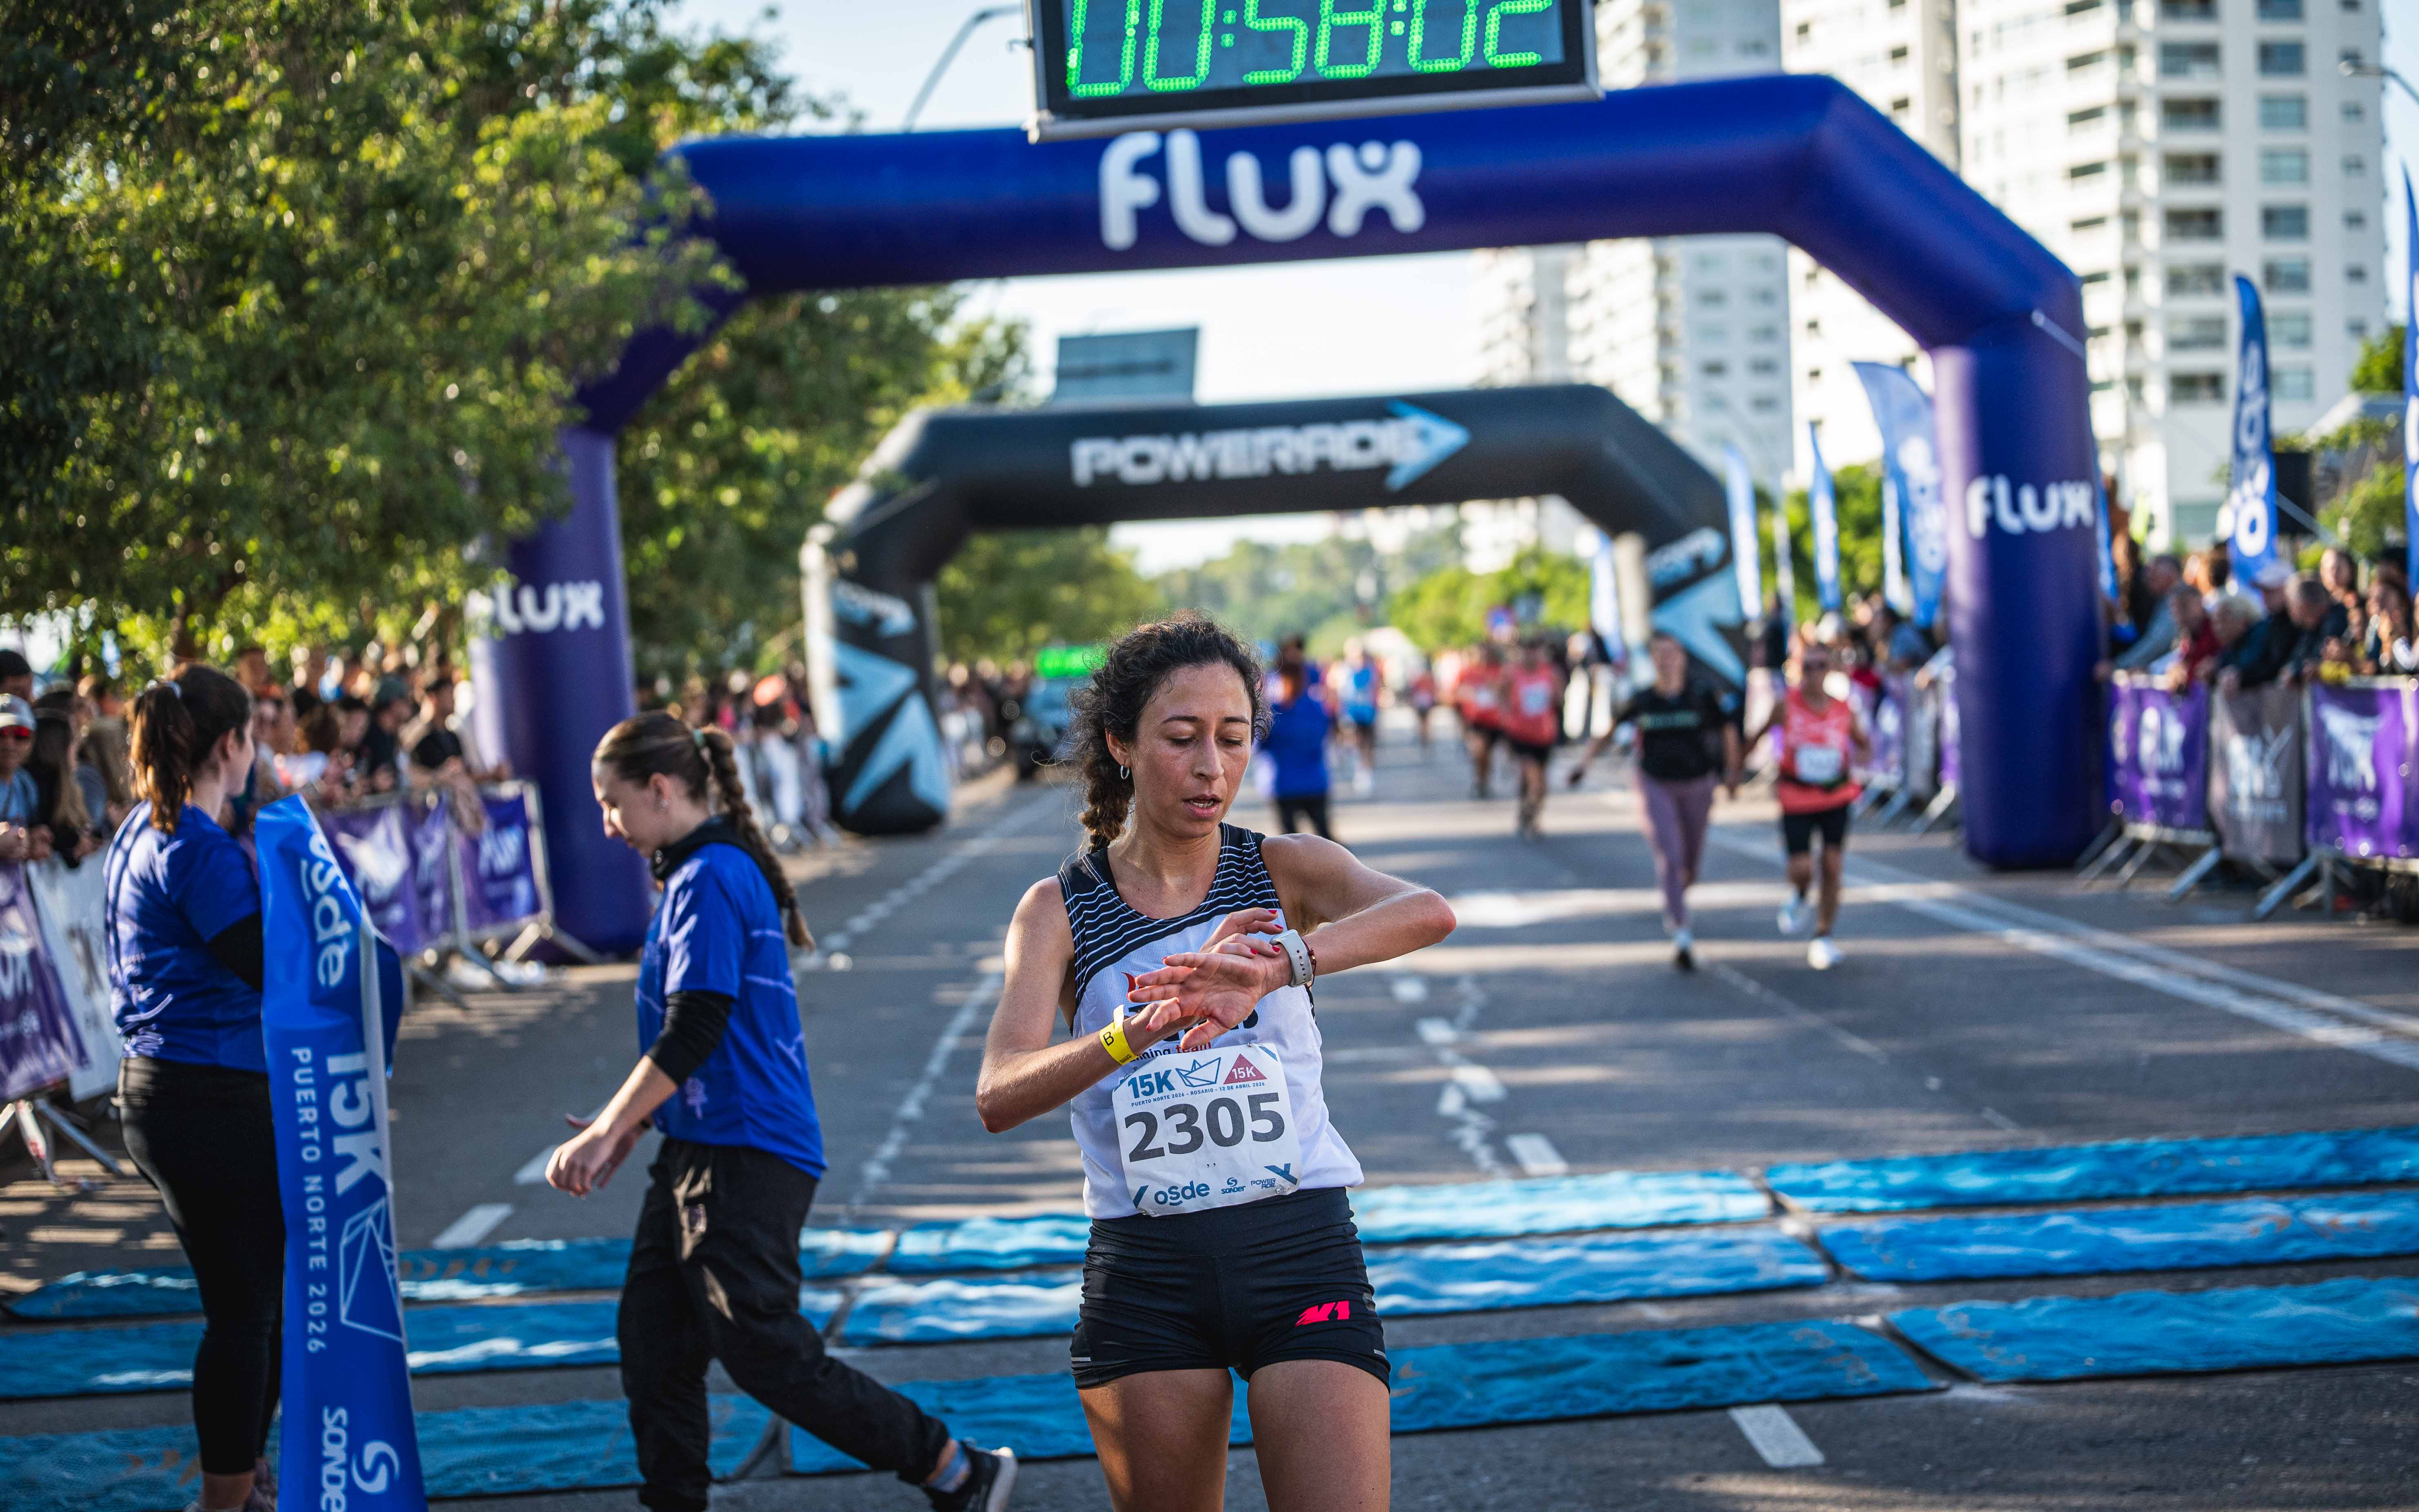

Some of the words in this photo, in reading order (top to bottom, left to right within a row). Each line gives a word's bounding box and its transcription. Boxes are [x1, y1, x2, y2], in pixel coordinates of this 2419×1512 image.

[1103, 1031, 1114, 1046] B
[1232, 1066, 1256, 1079] 15K
[291, 1047, 321, 1162] PUERTO
[1128, 1069, 1176, 1099] 15K
[1124, 1092, 1285, 1163] 2305
[303, 1175, 327, 1271] NORTE
[1154, 1180, 1211, 1206] osde
[307, 1283, 328, 1354] 2026
[320, 1405, 348, 1512] SONDe
